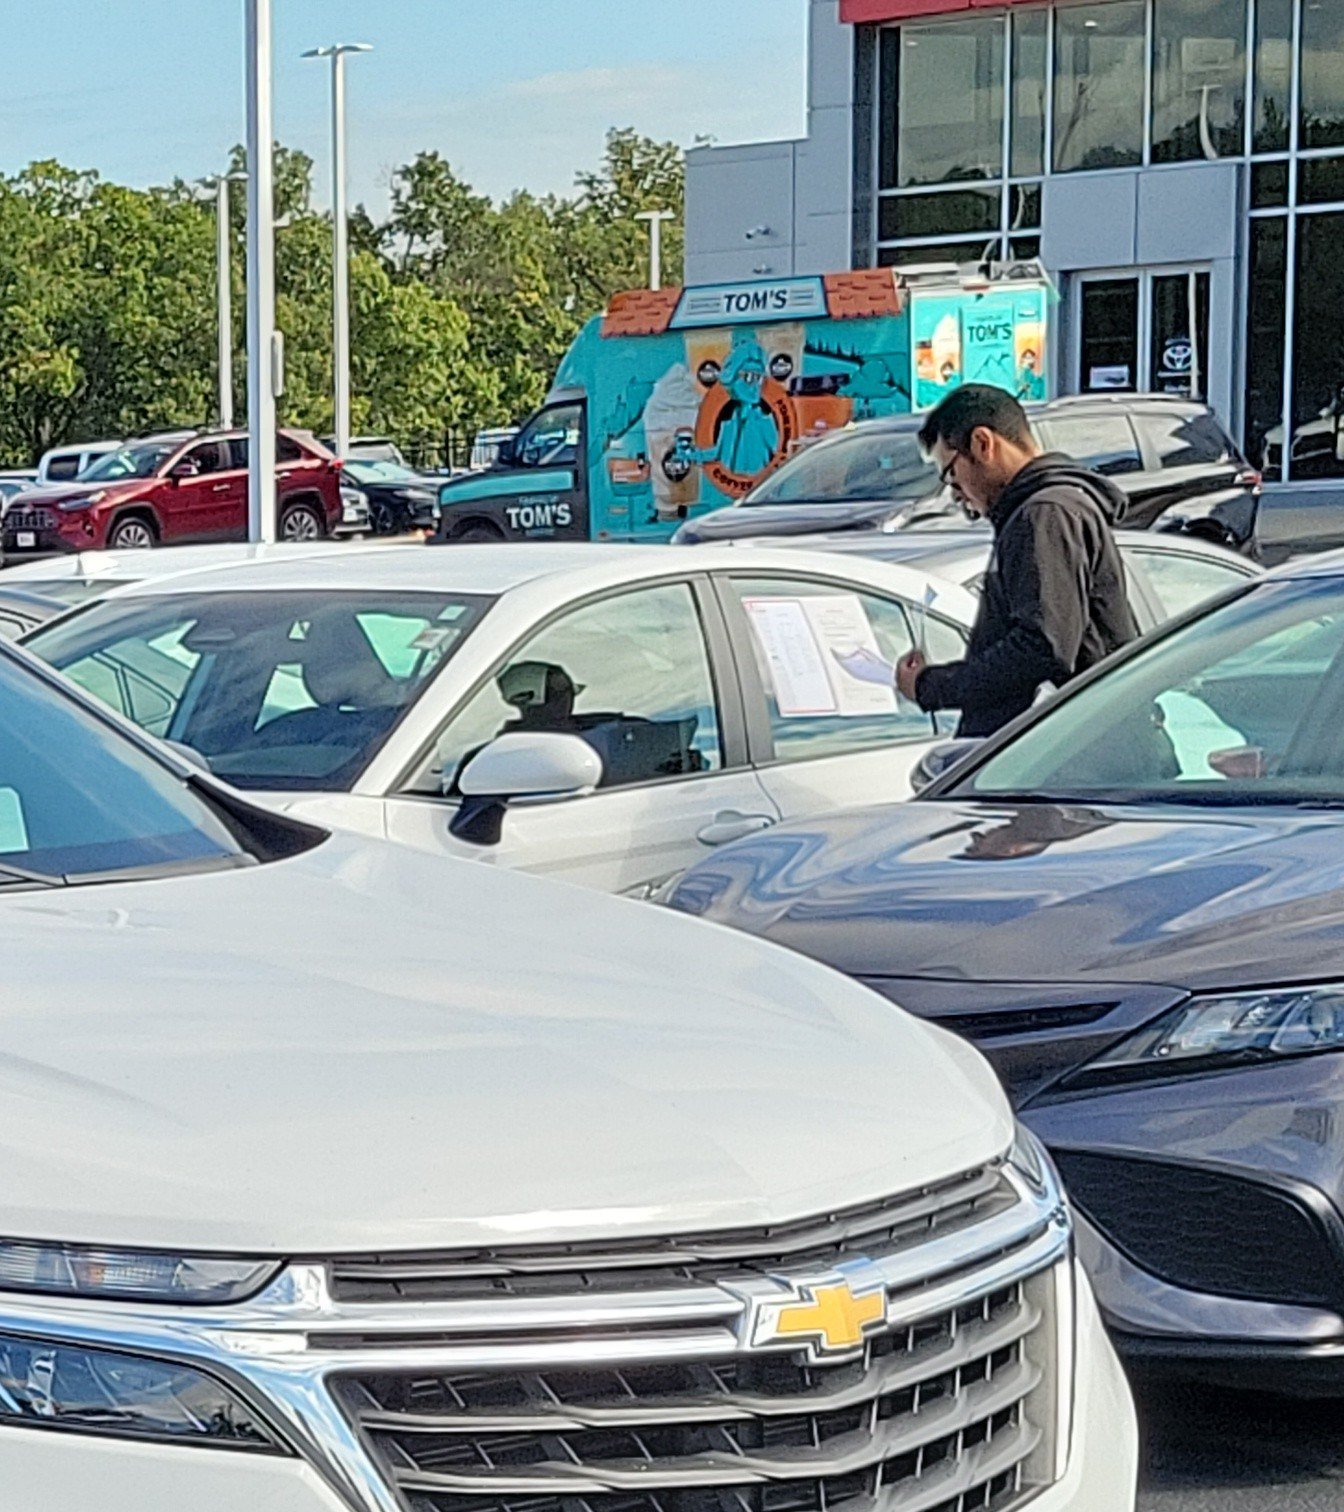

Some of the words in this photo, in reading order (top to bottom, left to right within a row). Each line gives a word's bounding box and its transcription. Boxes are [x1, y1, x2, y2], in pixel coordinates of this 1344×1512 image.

[723, 288, 788, 314] TOM'S
[967, 322, 1013, 343] TOM'S
[505, 503, 572, 530] TOM'S
